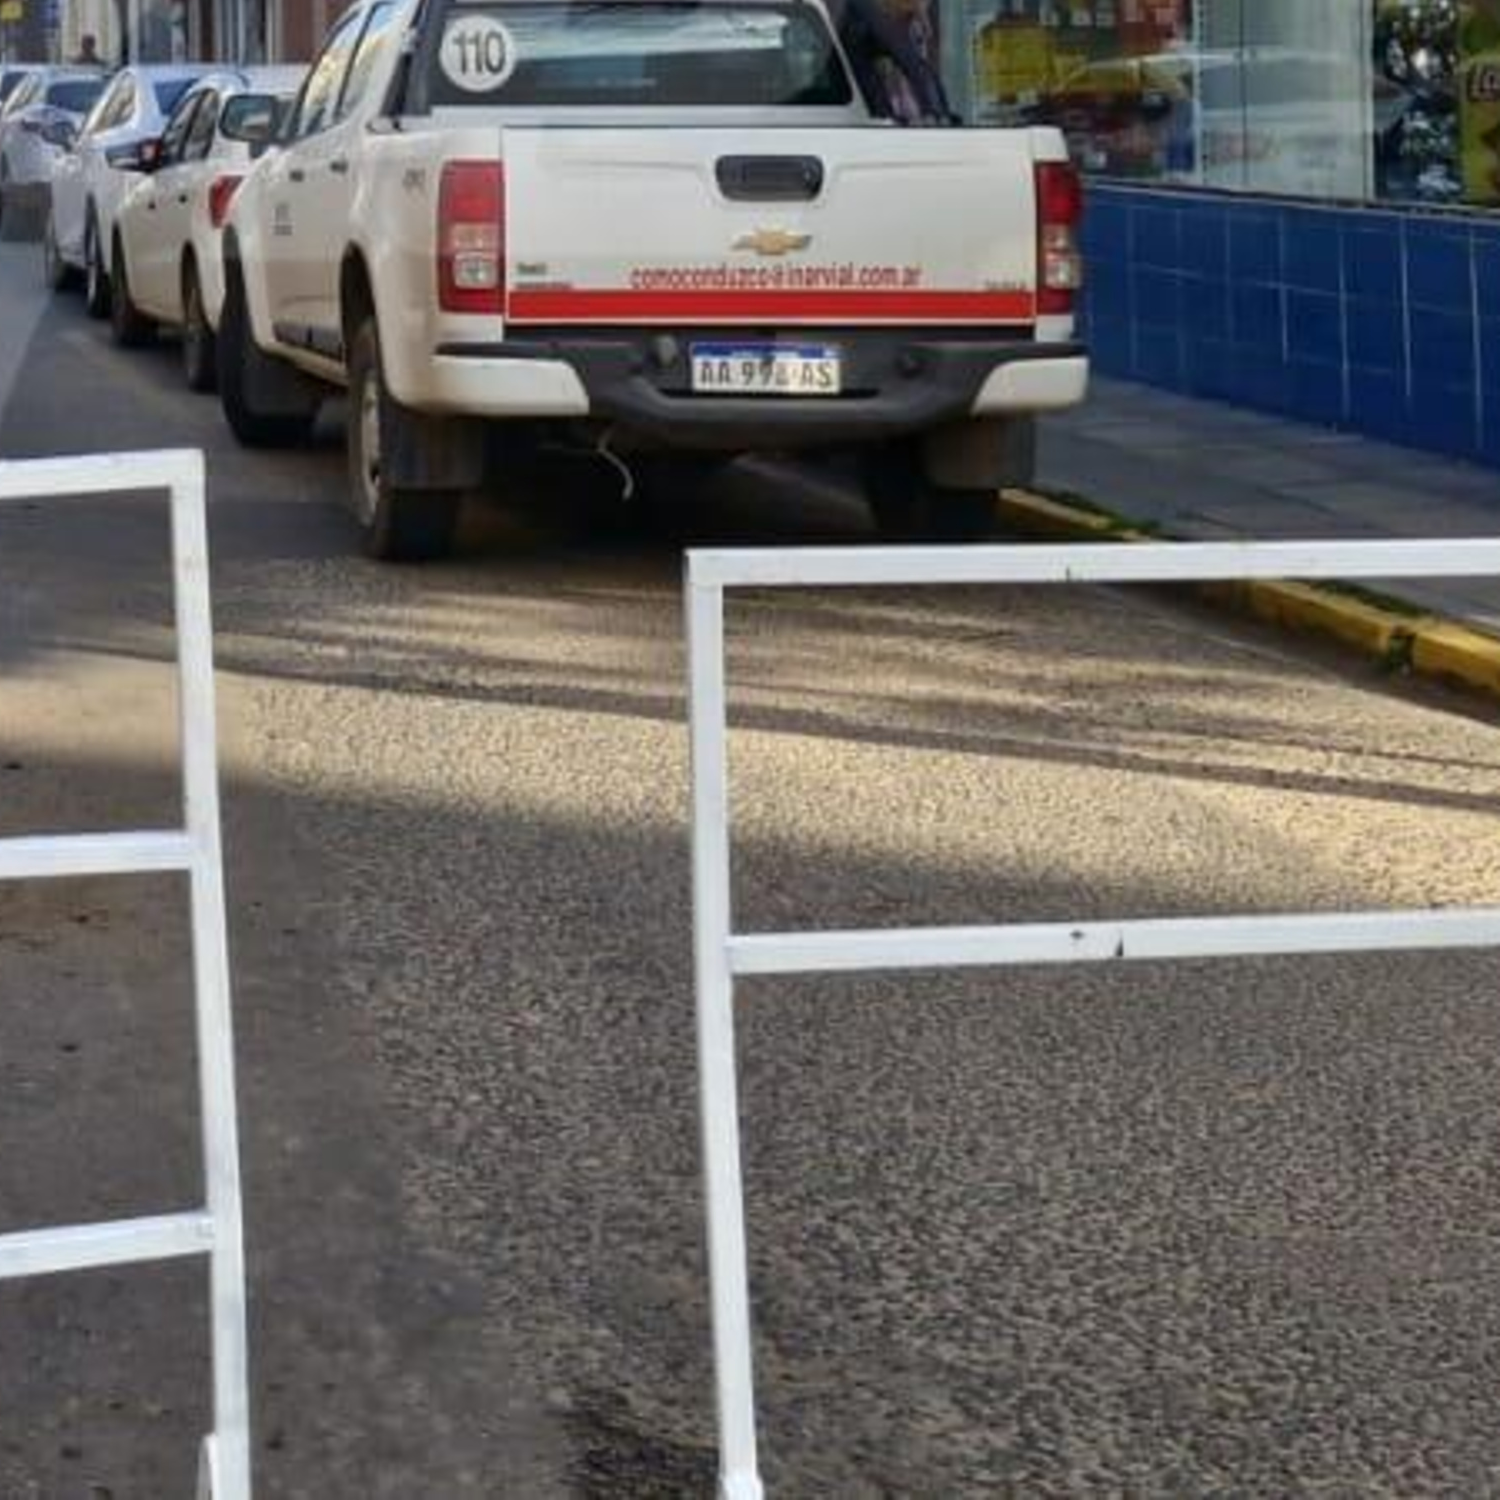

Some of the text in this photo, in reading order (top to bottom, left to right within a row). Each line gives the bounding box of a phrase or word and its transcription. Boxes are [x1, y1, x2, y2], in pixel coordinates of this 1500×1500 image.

[453, 31, 506, 75] 110
[700, 360, 731, 384] AA
[800, 361, 833, 388] AS
